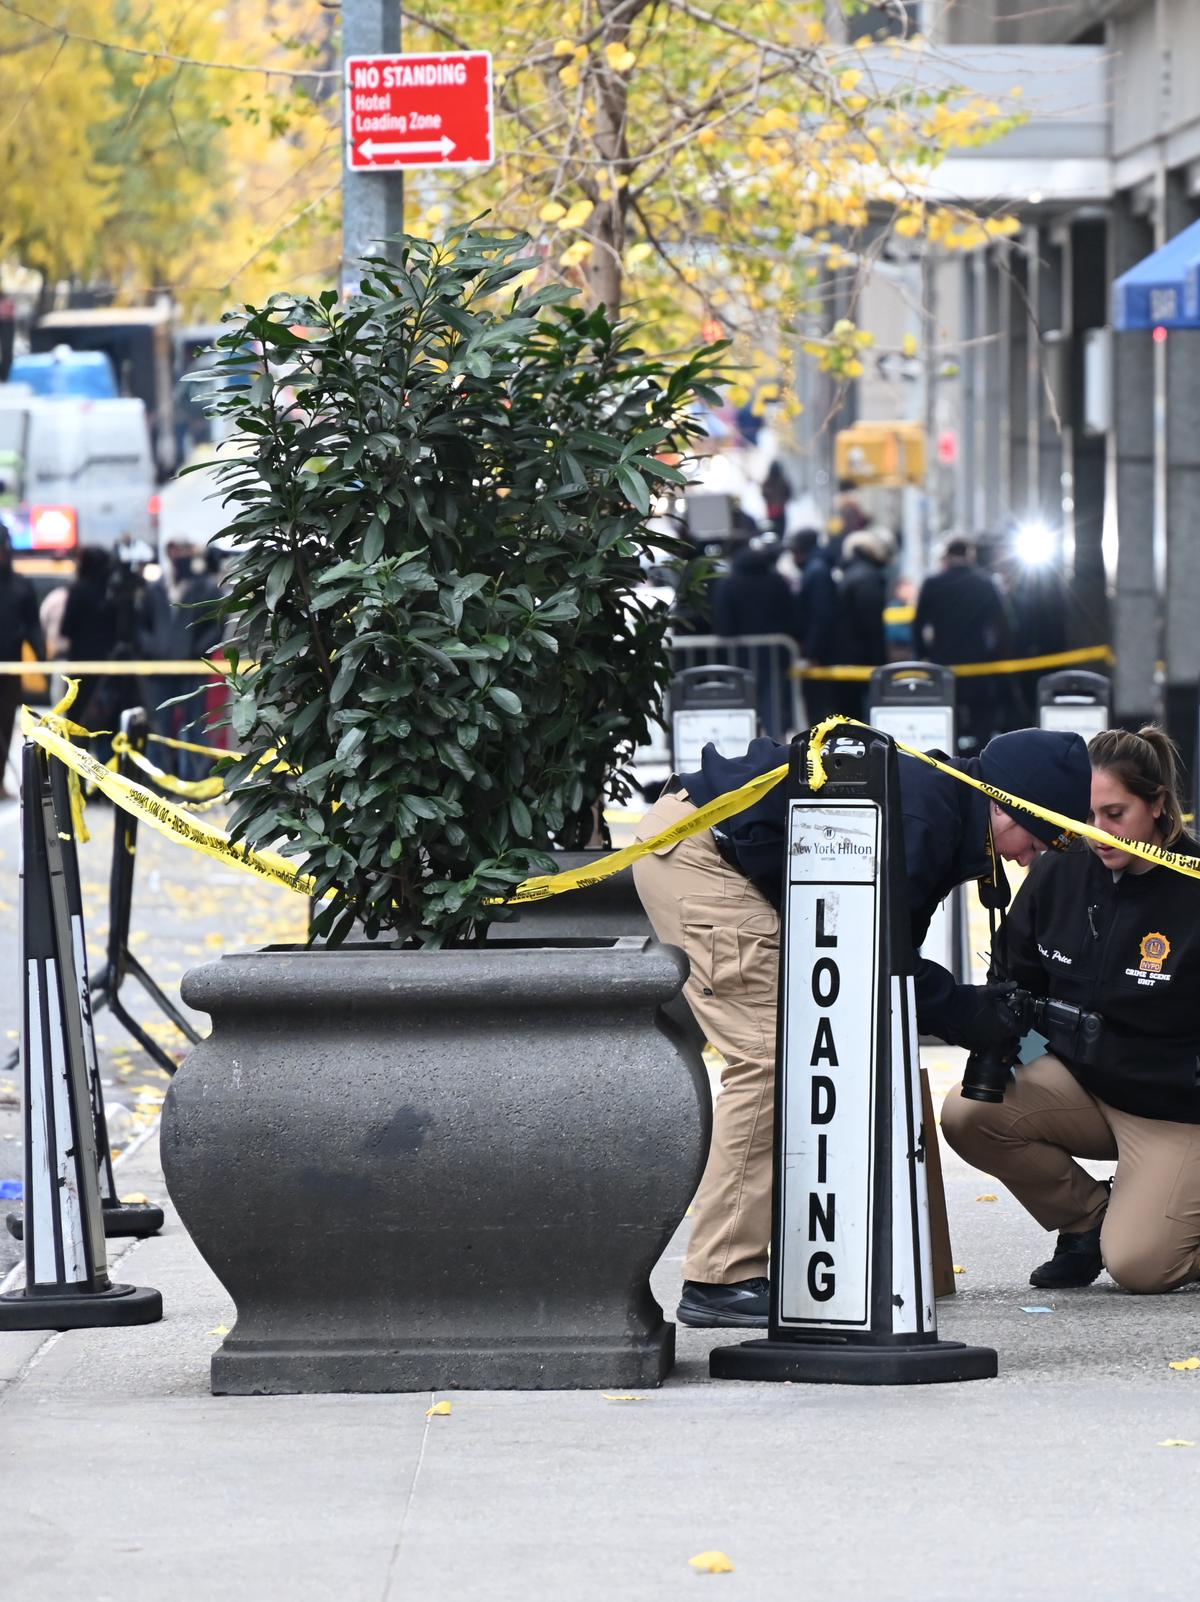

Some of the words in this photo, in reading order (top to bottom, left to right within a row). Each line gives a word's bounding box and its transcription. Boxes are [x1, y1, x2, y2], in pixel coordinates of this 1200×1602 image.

[355, 67, 379, 89] NO
[383, 63, 467, 88] STANDING
[355, 93, 391, 111] Hotel
[356, 113, 407, 133] Loading
[409, 112, 441, 129] Zone
[814, 842, 835, 855] York
[838, 842, 872, 855] Hilton
[1141, 961, 1161, 971] NYPD
[1125, 968, 1147, 978] CRIME
[1149, 972, 1171, 981] SCENE
[1137, 978, 1156, 987] UNIT
[807, 898, 841, 1302] LOADING
